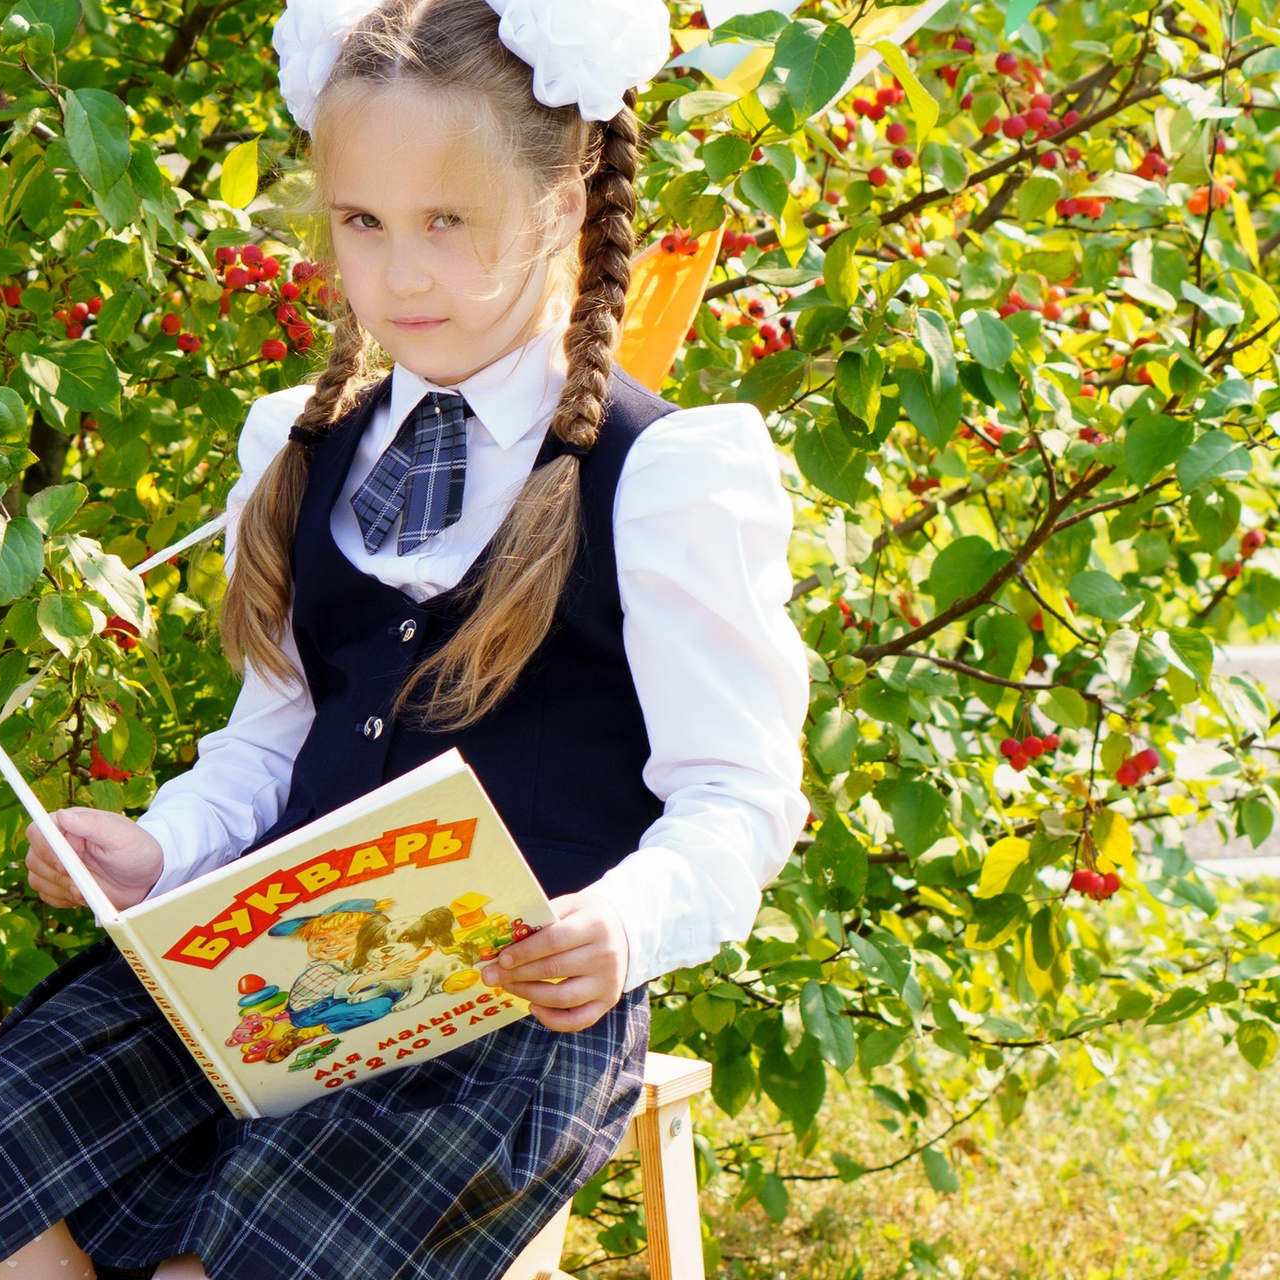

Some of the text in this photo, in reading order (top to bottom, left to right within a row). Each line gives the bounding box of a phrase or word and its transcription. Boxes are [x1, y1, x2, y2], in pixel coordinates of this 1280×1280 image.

[179, 828, 464, 962] БУКВАРЬ
[122, 949, 160, 992] БУКВАРЬ
[365, 1056, 387, 1071] 2
[439, 1023, 458, 1038] 5
